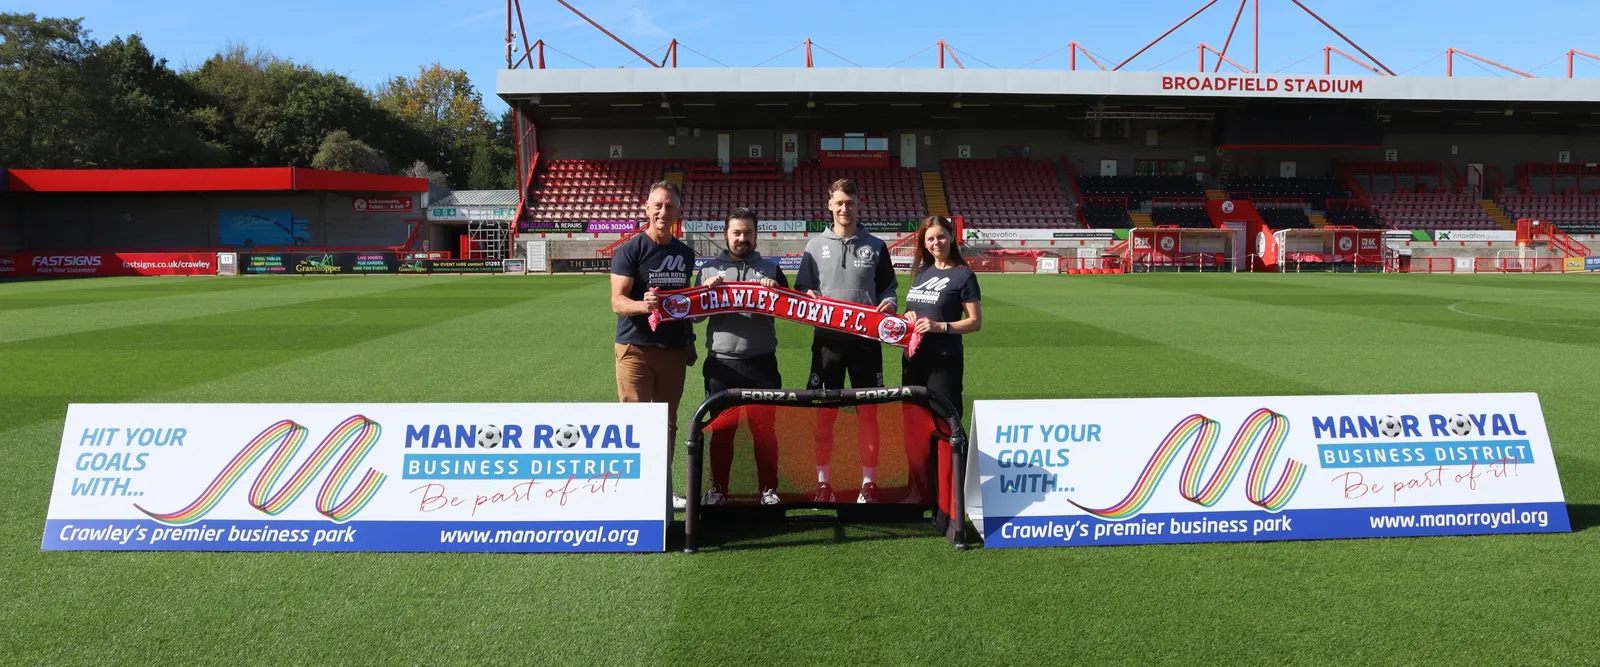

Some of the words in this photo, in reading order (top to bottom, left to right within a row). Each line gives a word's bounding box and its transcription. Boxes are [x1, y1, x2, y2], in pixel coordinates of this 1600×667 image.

[1162, 76, 1278, 92] BROADFIELD
[1284, 78, 1363, 93] STADIUM
[612, 149, 620, 157] A
[961, 148, 968, 156] C
[32, 256, 102, 266] FASTSIGNS
[123, 260, 210, 269] fastsigns.co.uk/crawley
[296, 264, 341, 273] Grasshopper
[700, 289, 780, 311] CRAWLEY
[787, 298, 836, 325] TOWN
[839, 308, 867, 332] F.C.
[741, 390, 798, 400] FORZA
[855, 387, 913, 400] FORZA
[996, 425, 1032, 443] HIT
[1040, 424, 1101, 442] YOUR
[1312, 414, 1423, 439] MANOR
[1429, 413, 1527, 437] ROYAL
[79, 428, 120, 447] HIT
[126, 428, 187, 446] YOUR
[405, 424, 522, 449] MANOR
[534, 424, 640, 448] ROYAL
[75, 452, 149, 471] GOALS
[997, 449, 1070, 468] GOALS
[1324, 447, 1426, 464] BUSINESS
[1436, 445, 1526, 462] DISTRICT
[408, 460, 519, 475] BUSINESS
[531, 459, 634, 474] DISTRICT
[71, 478, 145, 496] WITH...
[1000, 474, 1075, 493] WITH...
[1332, 471, 1384, 500] Be
[1393, 466, 1450, 503] part
[1454, 460, 1481, 491] of
[1486, 456, 1518, 478] it!
[410, 483, 464, 512] Be
[471, 479, 543, 517] part
[546, 474, 577, 506] of
[583, 471, 623, 494] it!
[1001, 520, 1089, 540] Crawley's
[1094, 518, 1165, 540] premier
[1170, 515, 1248, 535] business
[1253, 515, 1292, 536] park
[1369, 507, 1548, 529] www.manorroyal.org
[60, 525, 147, 545] Crawley's
[150, 526, 224, 544] premier
[228, 525, 310, 543] business
[312, 526, 356, 546] park
[440, 526, 639, 546] www.manorroyal.org
